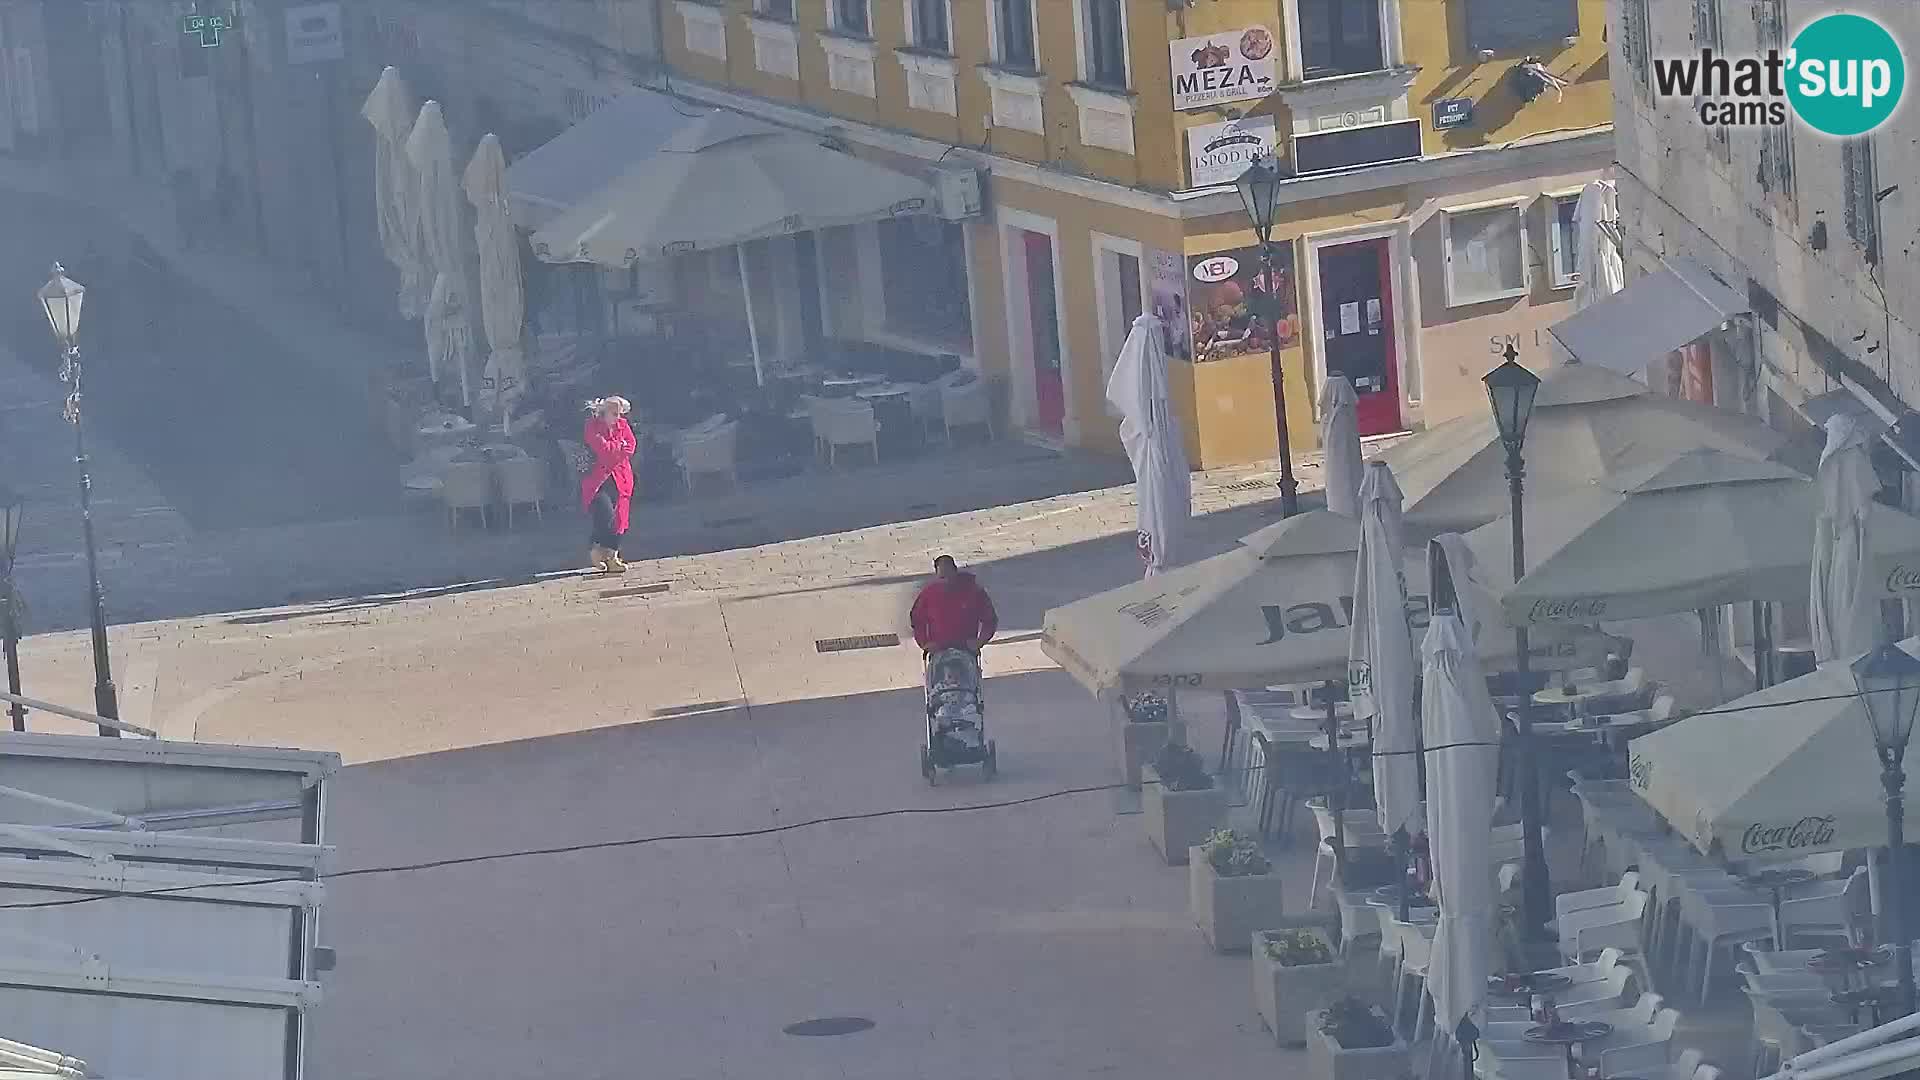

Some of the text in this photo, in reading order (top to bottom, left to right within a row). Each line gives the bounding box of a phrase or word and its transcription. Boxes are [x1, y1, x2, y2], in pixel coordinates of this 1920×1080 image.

[1176, 64, 1255, 95] MEZA
[1226, 87, 1249, 97] GRILL
[1195, 151, 1240, 169] ISPOD
